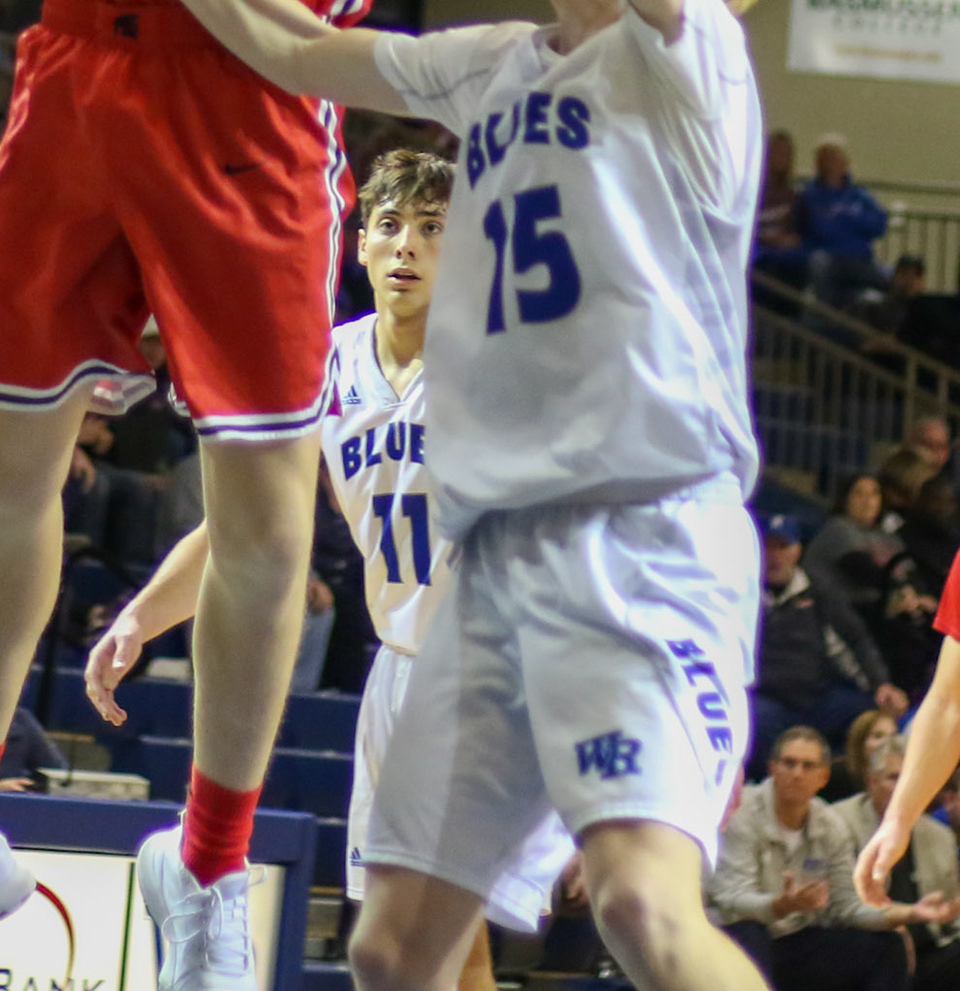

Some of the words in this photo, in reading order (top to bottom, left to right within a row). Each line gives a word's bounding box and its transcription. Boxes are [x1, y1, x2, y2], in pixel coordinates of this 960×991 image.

[483, 184, 581, 336] 15
[373, 493, 431, 586] 11
[574, 730, 643, 781] WR
